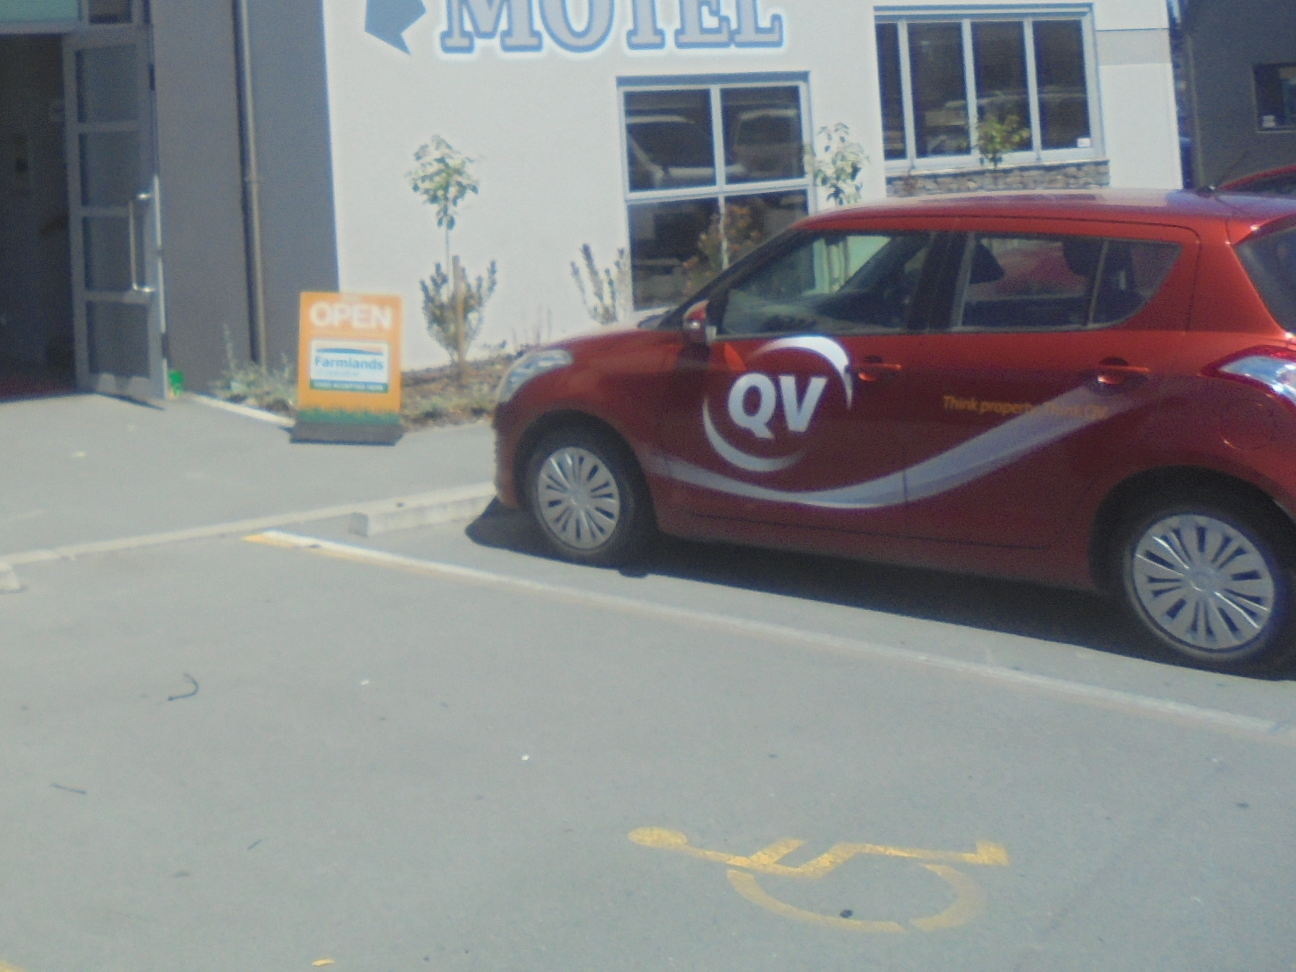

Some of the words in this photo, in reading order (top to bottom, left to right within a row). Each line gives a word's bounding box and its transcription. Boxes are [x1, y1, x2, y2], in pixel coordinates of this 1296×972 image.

[310, 301, 393, 330] OPEN
[315, 355, 384, 370] Farmlands
[727, 372, 828, 439] QV
